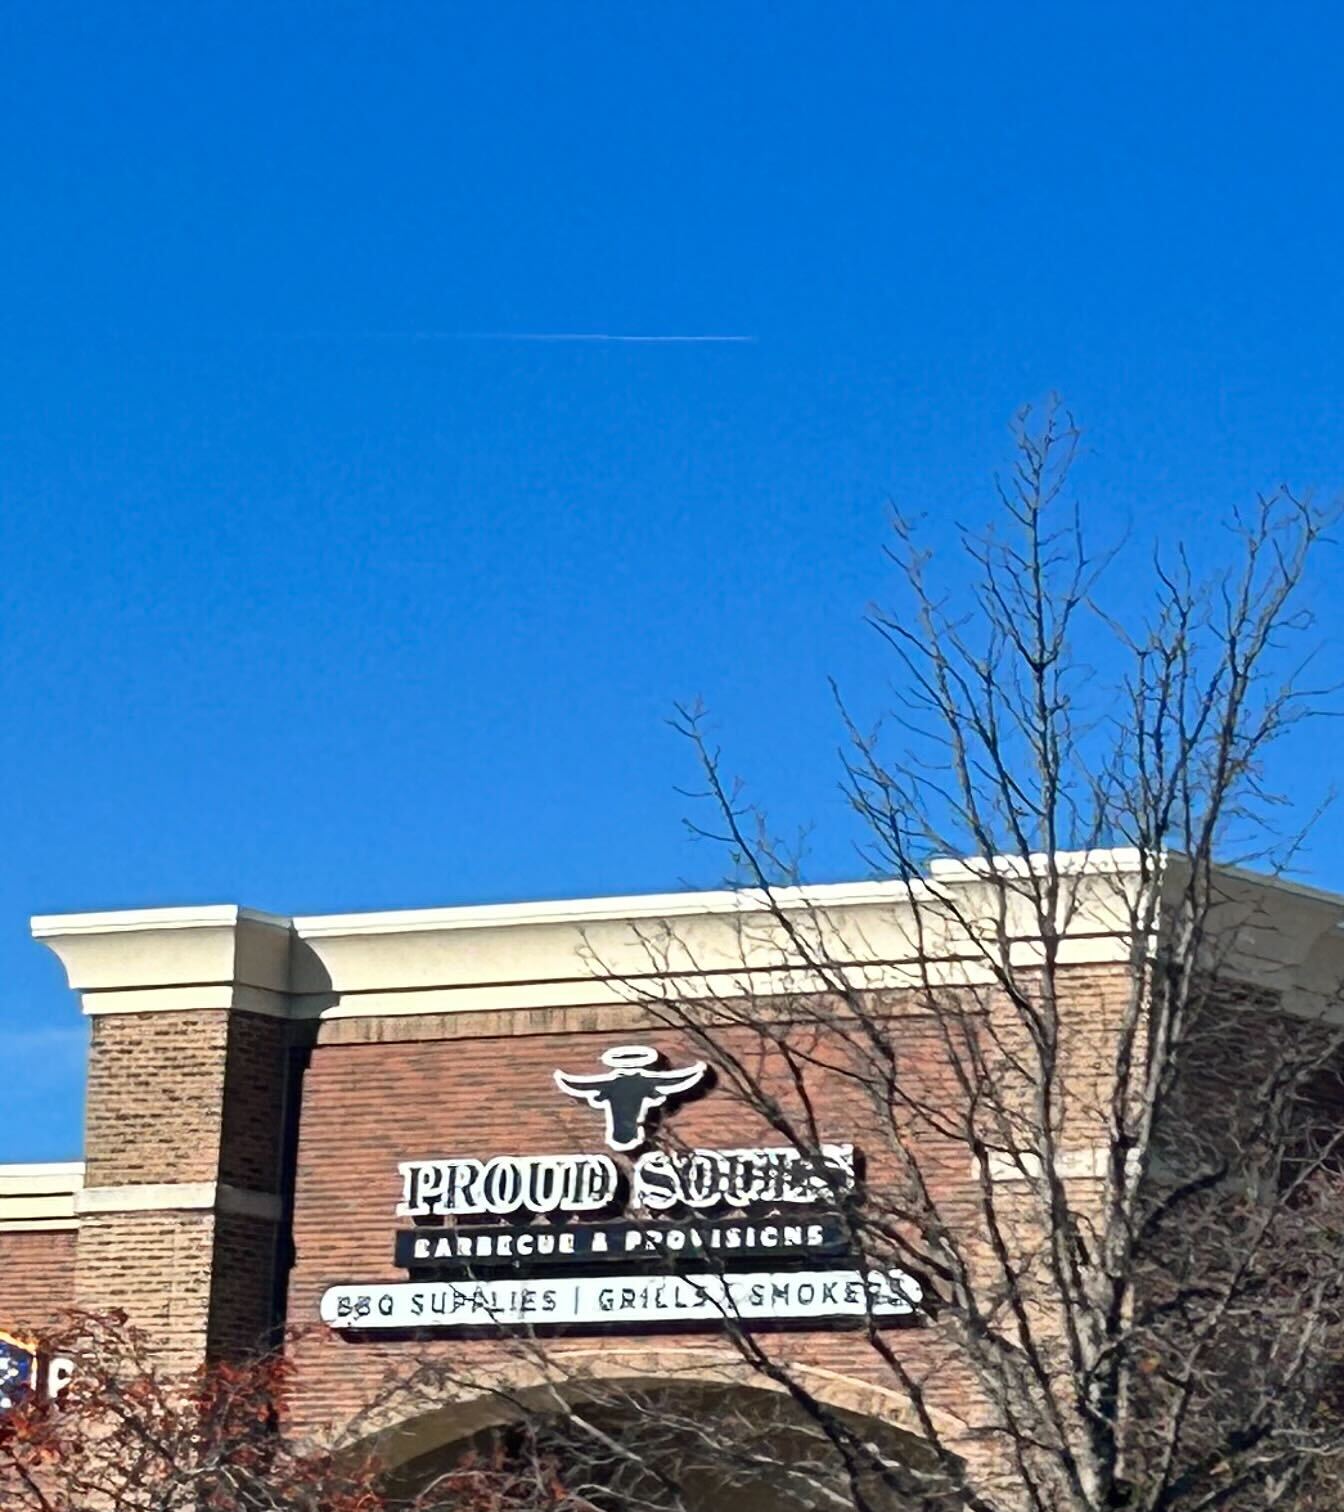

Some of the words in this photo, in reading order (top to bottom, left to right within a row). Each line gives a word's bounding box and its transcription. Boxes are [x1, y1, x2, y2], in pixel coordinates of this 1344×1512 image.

[397, 1154, 618, 1216] PROUD
[414, 1233, 575, 1259] BARBECUE
[625, 1224, 823, 1251] PROVISIONS
[337, 1294, 394, 1317] BBQ
[410, 1288, 557, 1314] SUPPLIES
